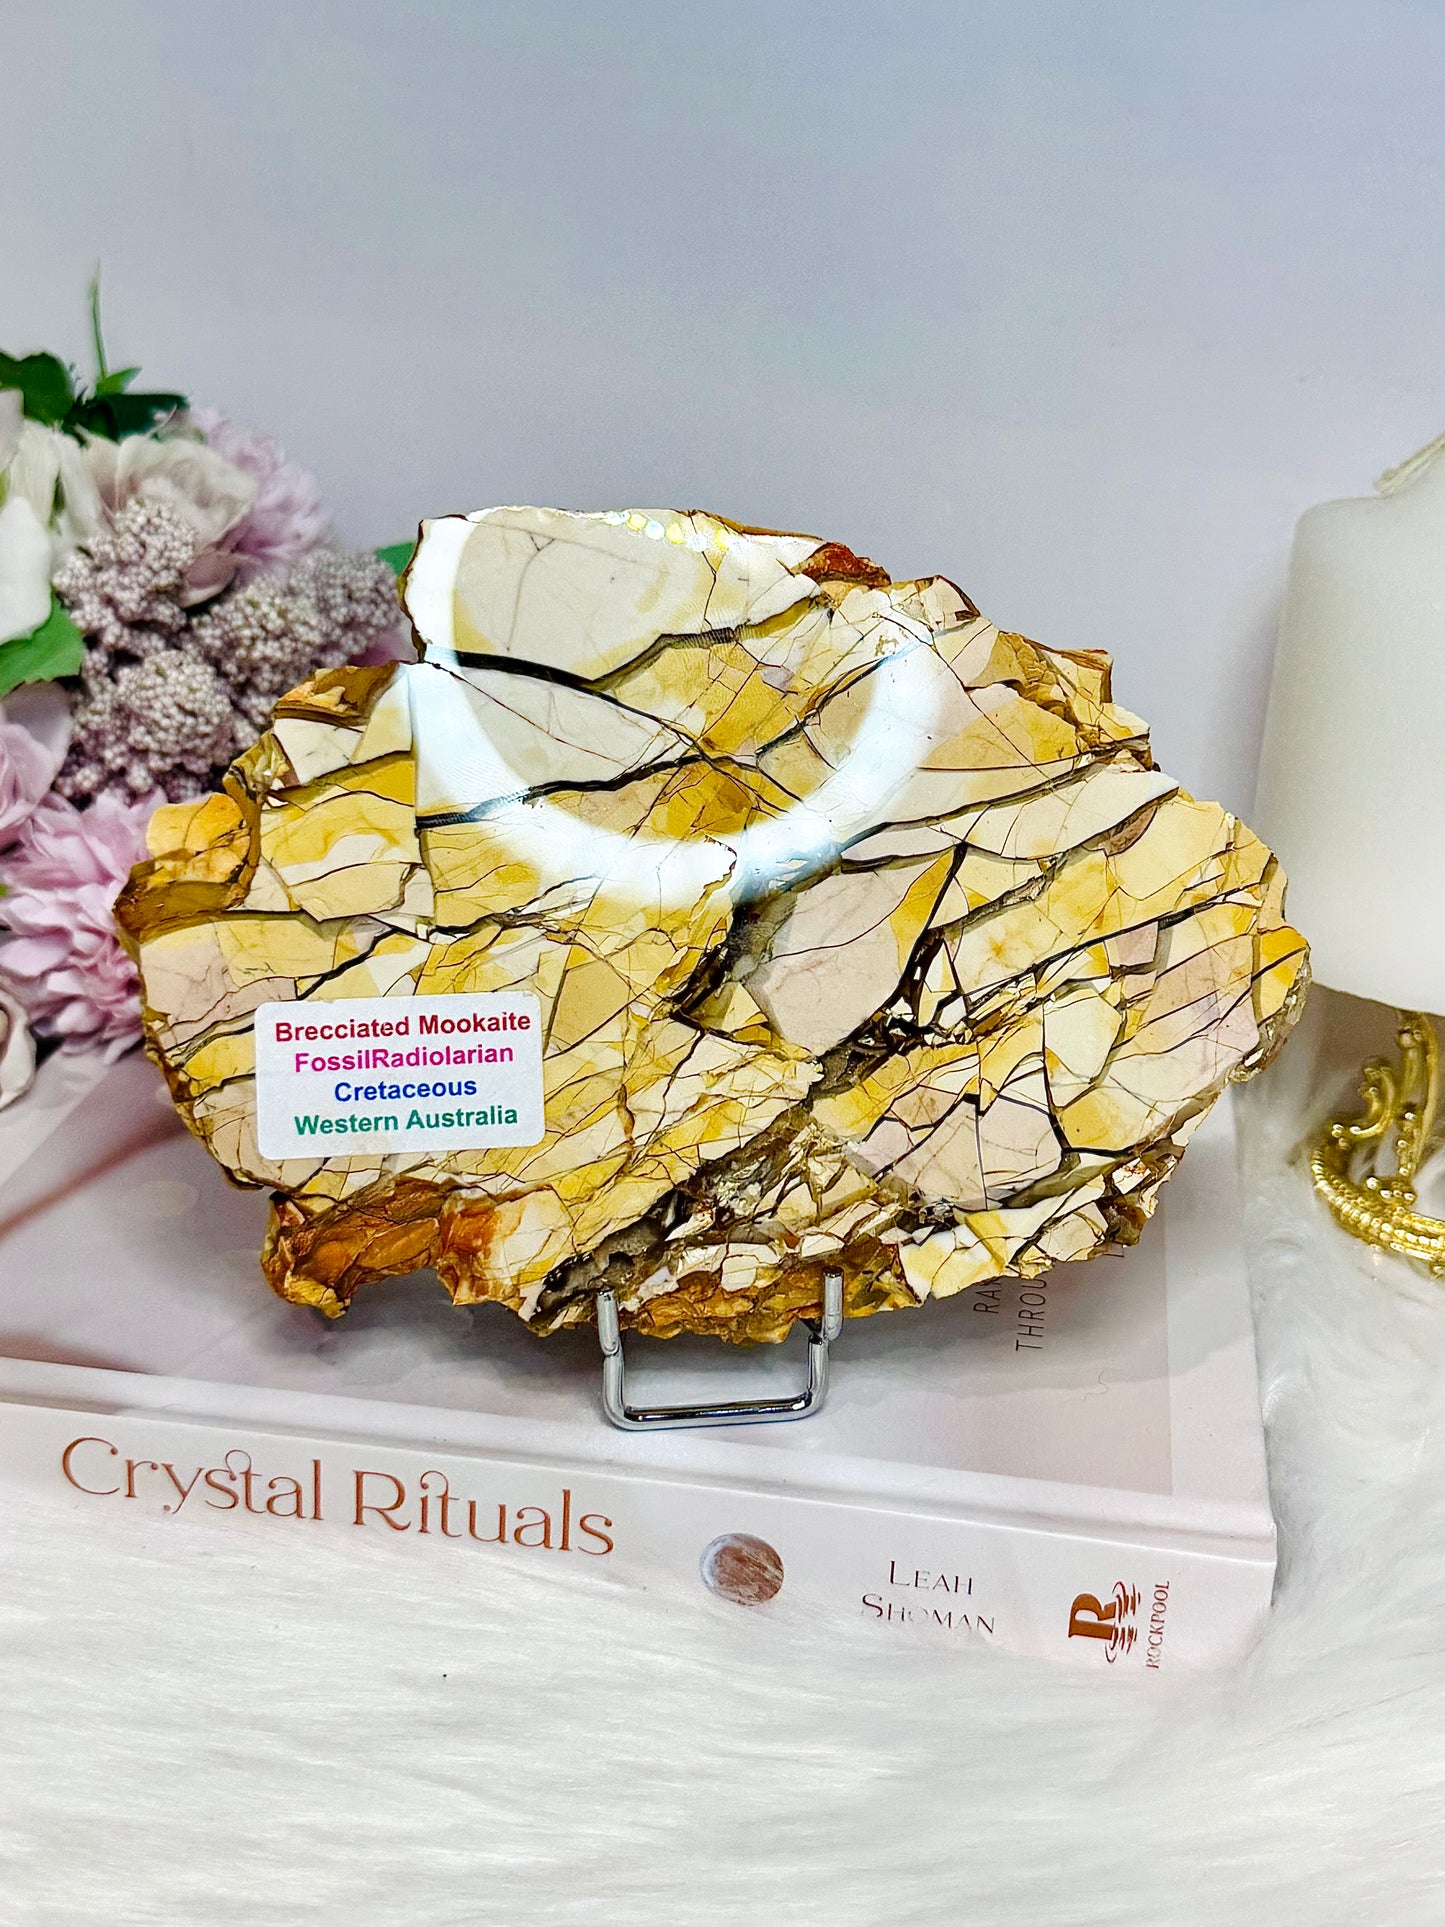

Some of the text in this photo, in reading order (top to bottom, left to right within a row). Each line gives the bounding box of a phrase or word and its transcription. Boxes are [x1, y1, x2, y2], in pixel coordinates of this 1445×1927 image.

[275, 1011, 531, 1042] Brecciated Mookaite
[294, 1044, 514, 1073] FossilRadiolarian
[334, 1080, 477, 1103] Cretaceous
[294, 1105, 518, 1136] Western Australia
[61, 1437, 615, 1556] Crystal Rituals
[1145, 1580, 1170, 1669] ROCKPOOL
